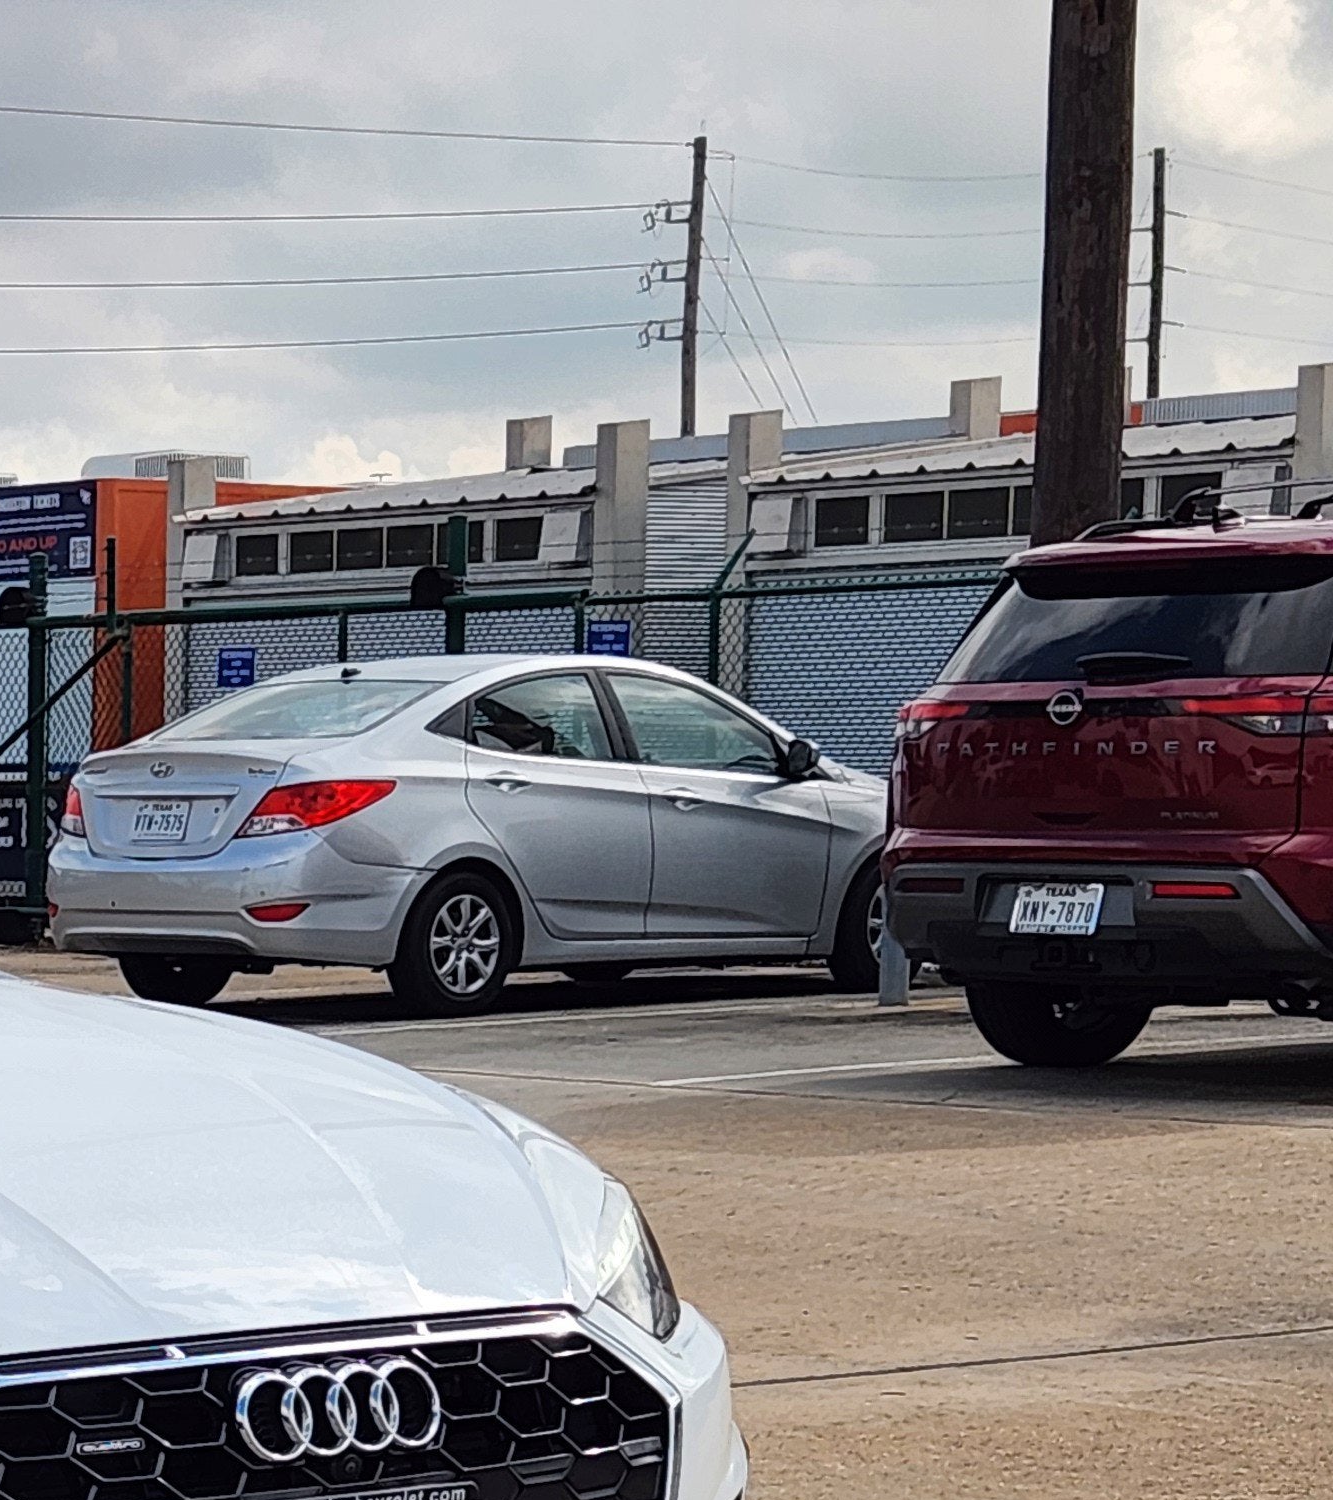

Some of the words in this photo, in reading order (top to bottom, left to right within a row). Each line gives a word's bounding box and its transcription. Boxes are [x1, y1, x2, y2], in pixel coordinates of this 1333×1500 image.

[9, 537, 37, 551] AND
[39, 535, 58, 550] UP
[936, 740, 1217, 756] PATHFINDER
[1046, 886, 1077, 897] TEXAS
